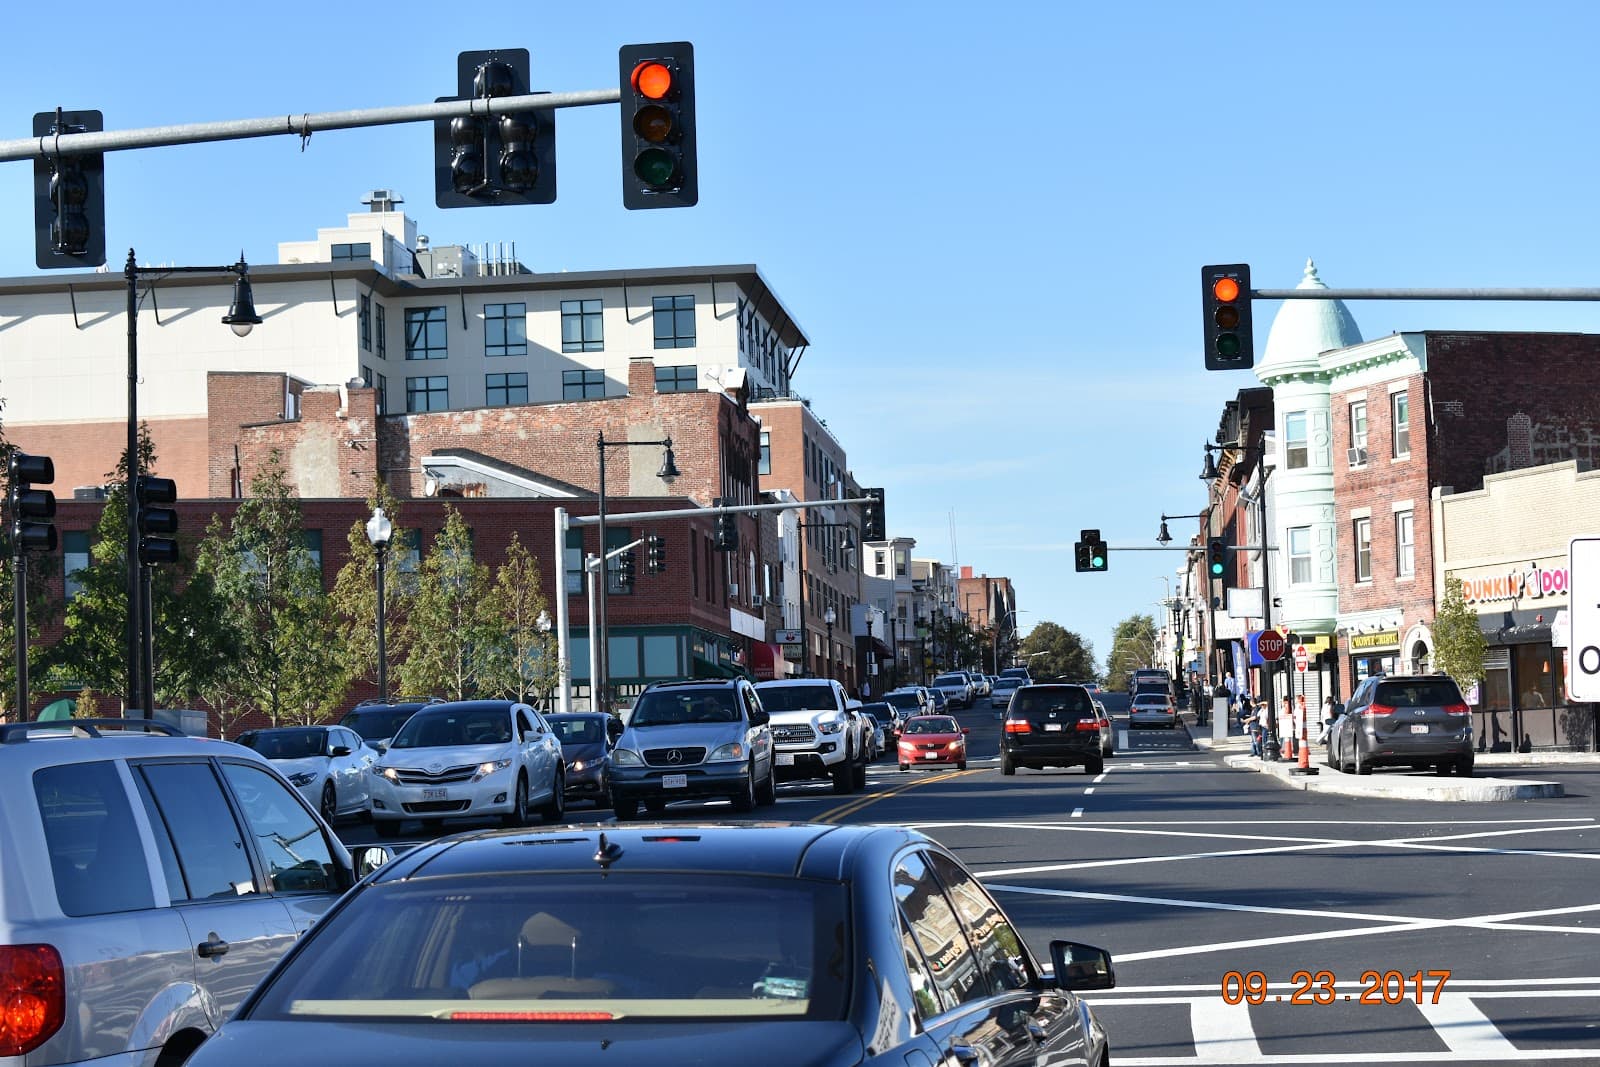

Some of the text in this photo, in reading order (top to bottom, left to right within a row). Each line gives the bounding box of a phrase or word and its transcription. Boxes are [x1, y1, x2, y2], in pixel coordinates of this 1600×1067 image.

[1463, 569, 1568, 600] DUNKIN' DO
[1259, 639, 1283, 652] STOP
